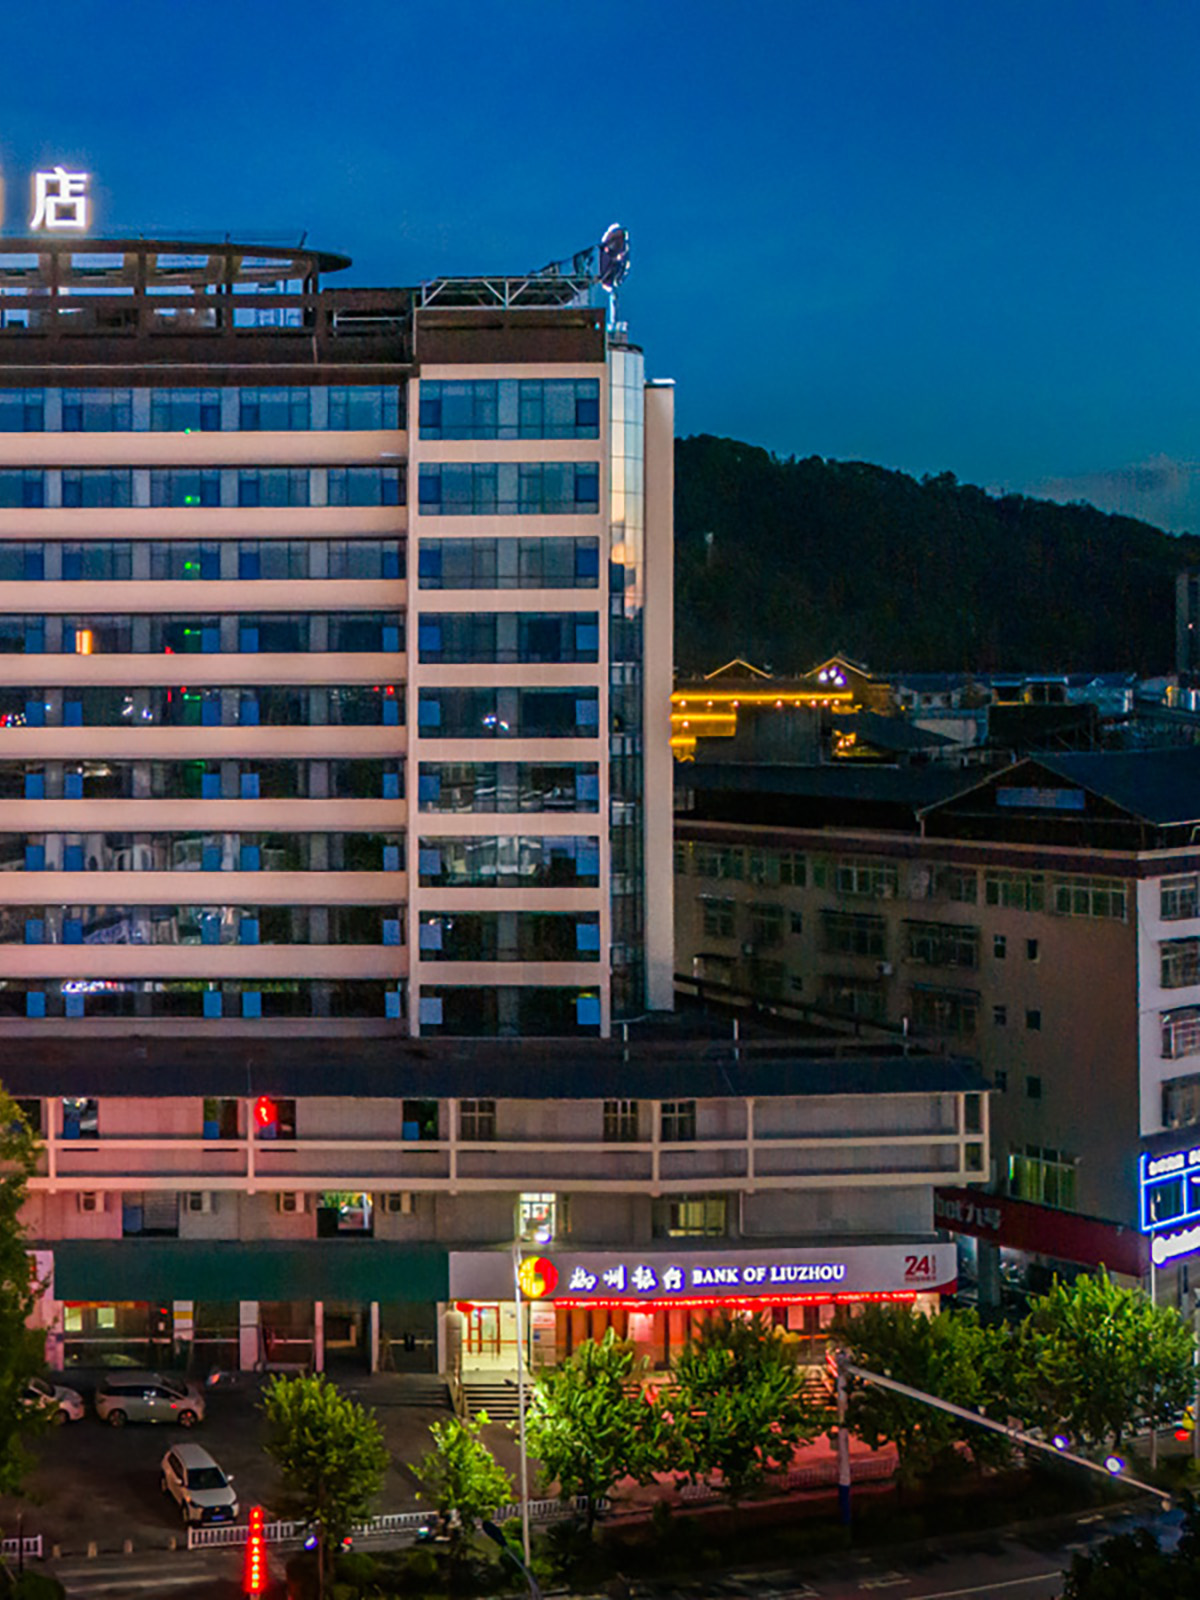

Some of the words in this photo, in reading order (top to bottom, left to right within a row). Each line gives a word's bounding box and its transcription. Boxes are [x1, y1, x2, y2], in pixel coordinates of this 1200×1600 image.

[692, 1267, 739, 1285] BANK
[743, 1267, 766, 1283] OF
[770, 1264, 846, 1282] LIUZHOU
[904, 1255, 930, 1276] 24
